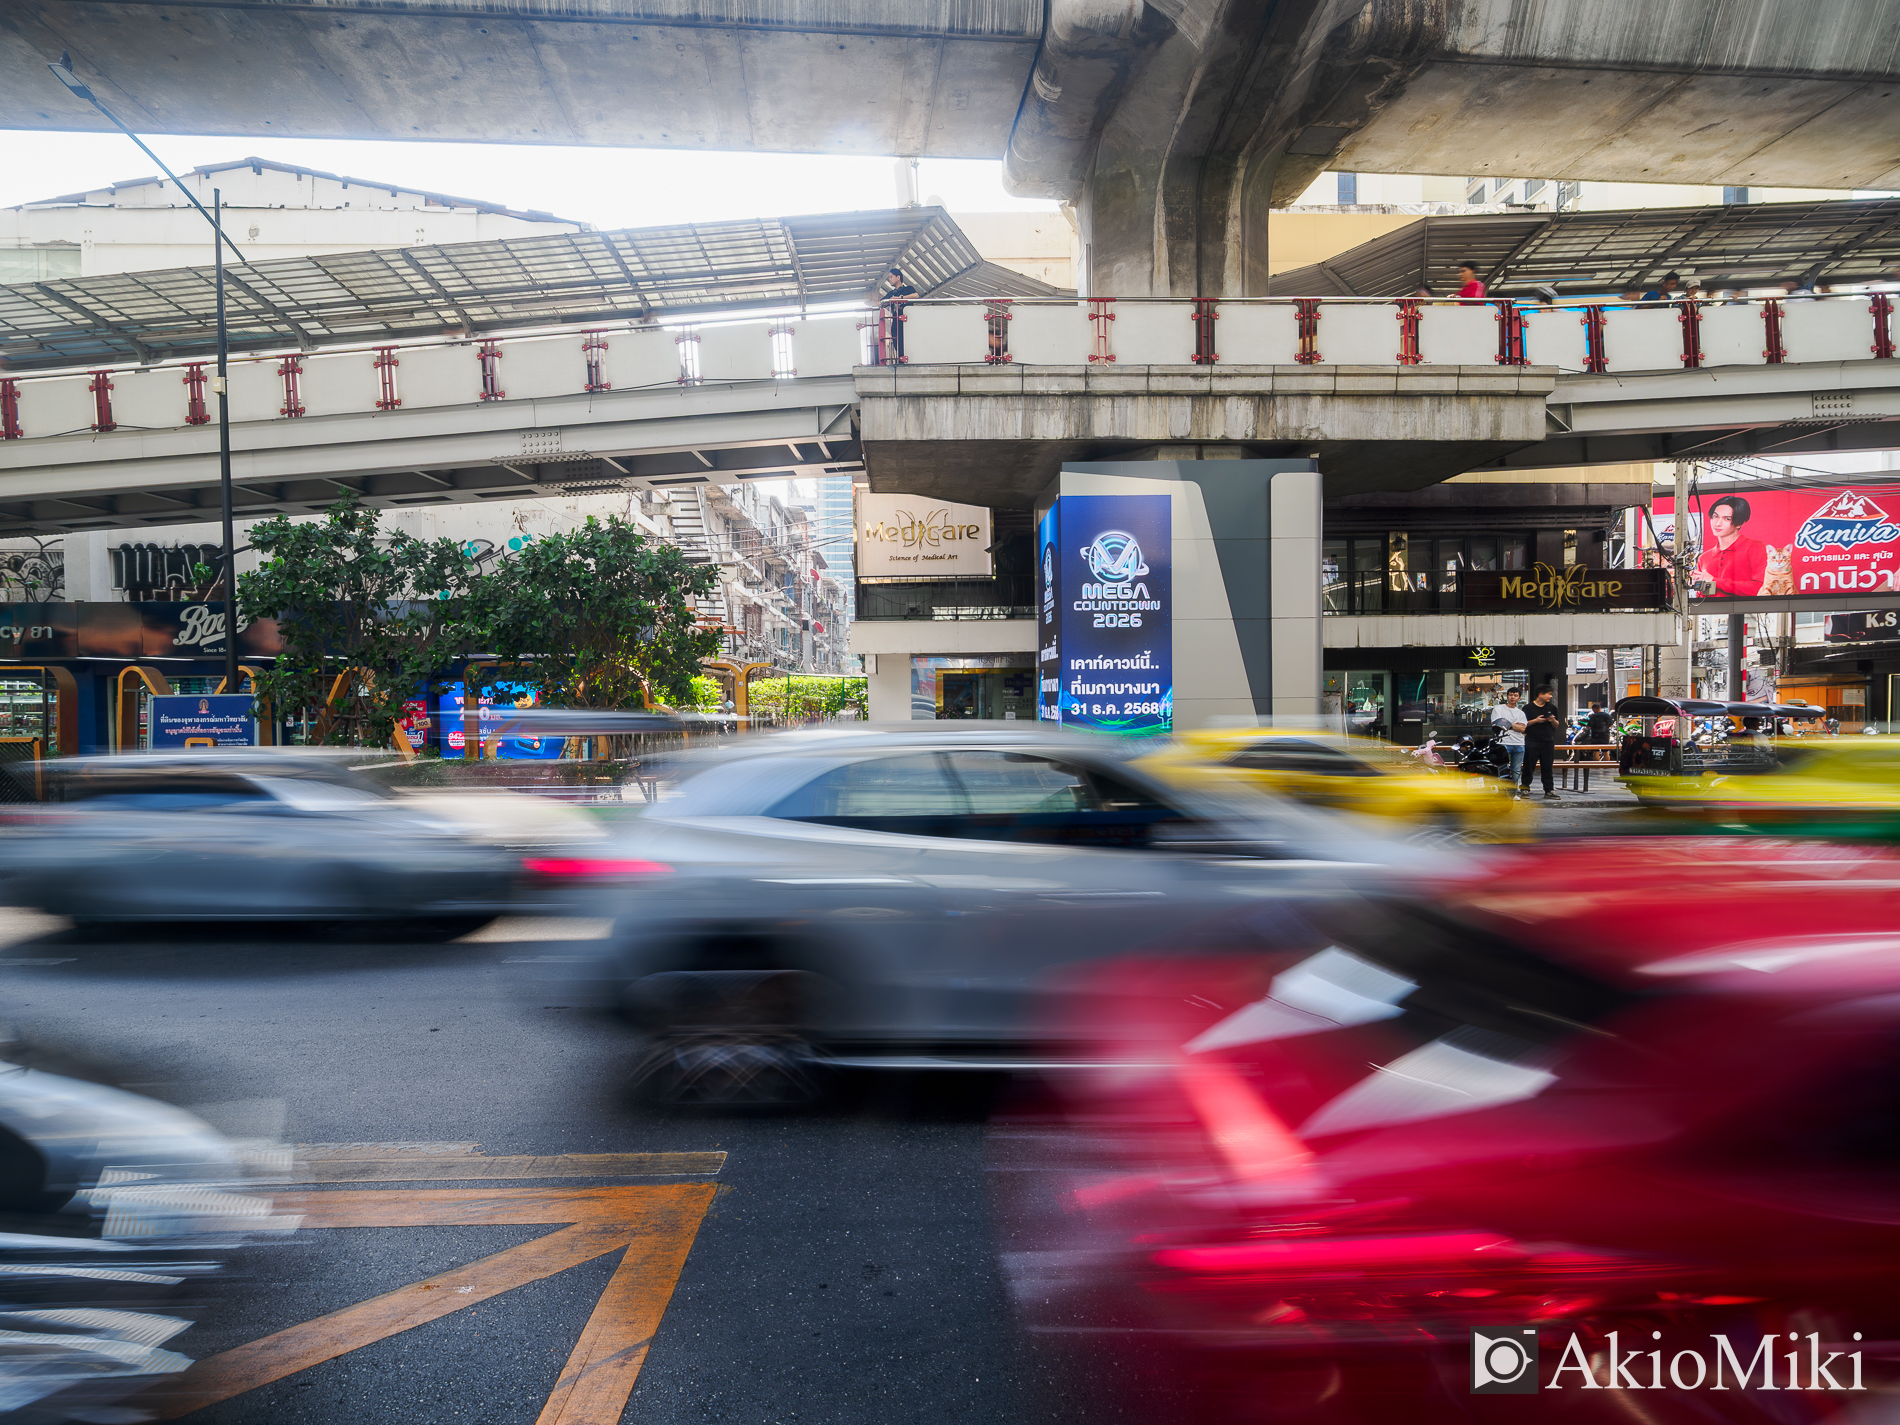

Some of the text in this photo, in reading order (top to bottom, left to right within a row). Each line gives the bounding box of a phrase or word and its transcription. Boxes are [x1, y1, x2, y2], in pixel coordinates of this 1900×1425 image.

[1798, 521, 1896, 550] Kaniva
[913, 554, 919, 562] of
[921, 553, 945, 561] Medical
[1802, 554, 1851, 563] อาหารแมว
[1800, 562, 1894, 590] คานิว่า
[1081, 582, 1150, 600] MEGA
[1073, 600, 1161, 611] COUNTDOWN
[1092, 613, 1143, 628] 2026
[31, 626, 53, 639] ยา
[1070, 675, 1160, 695] ที่เมกาบางนา
[1070, 702, 1087, 715] 31
[1092, 703, 1120, 715] ธ.ค.
[1124, 702, 1159, 715] 2568
